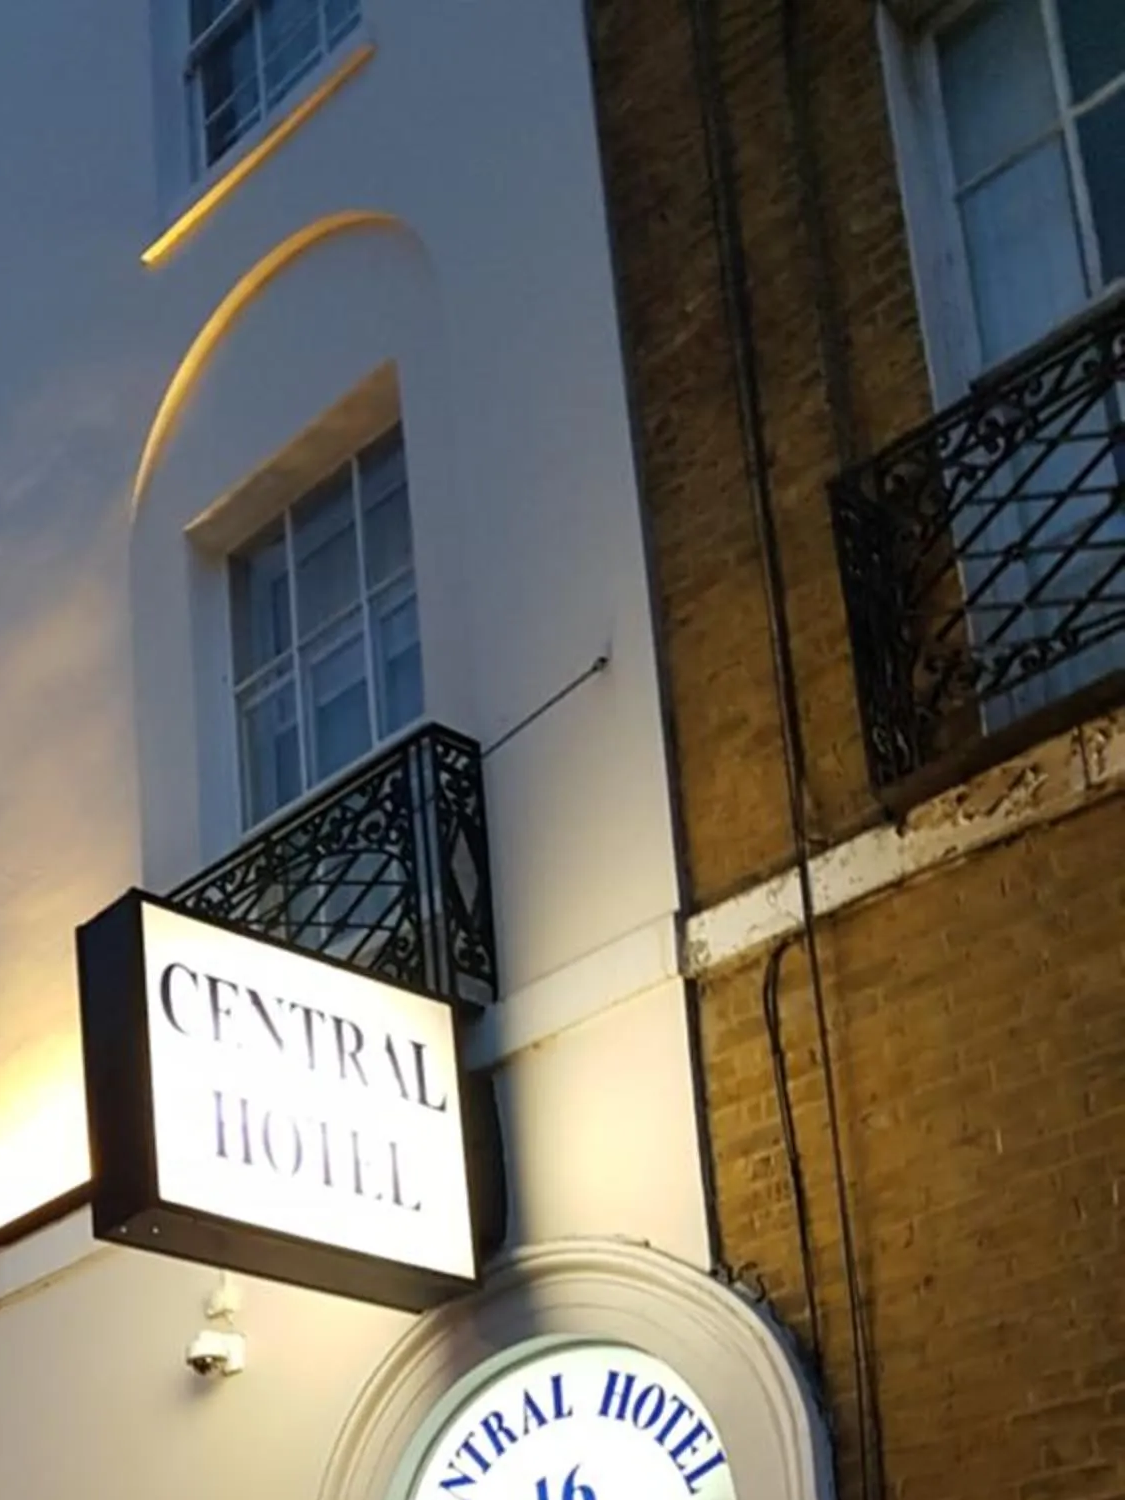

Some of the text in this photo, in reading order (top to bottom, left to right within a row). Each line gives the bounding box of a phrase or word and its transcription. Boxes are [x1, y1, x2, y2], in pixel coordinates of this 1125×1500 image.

[160, 962, 448, 1113] CENTRAL
[213, 1089, 422, 1212] HOTEL
[598, 1369, 728, 1496] HOTEL
